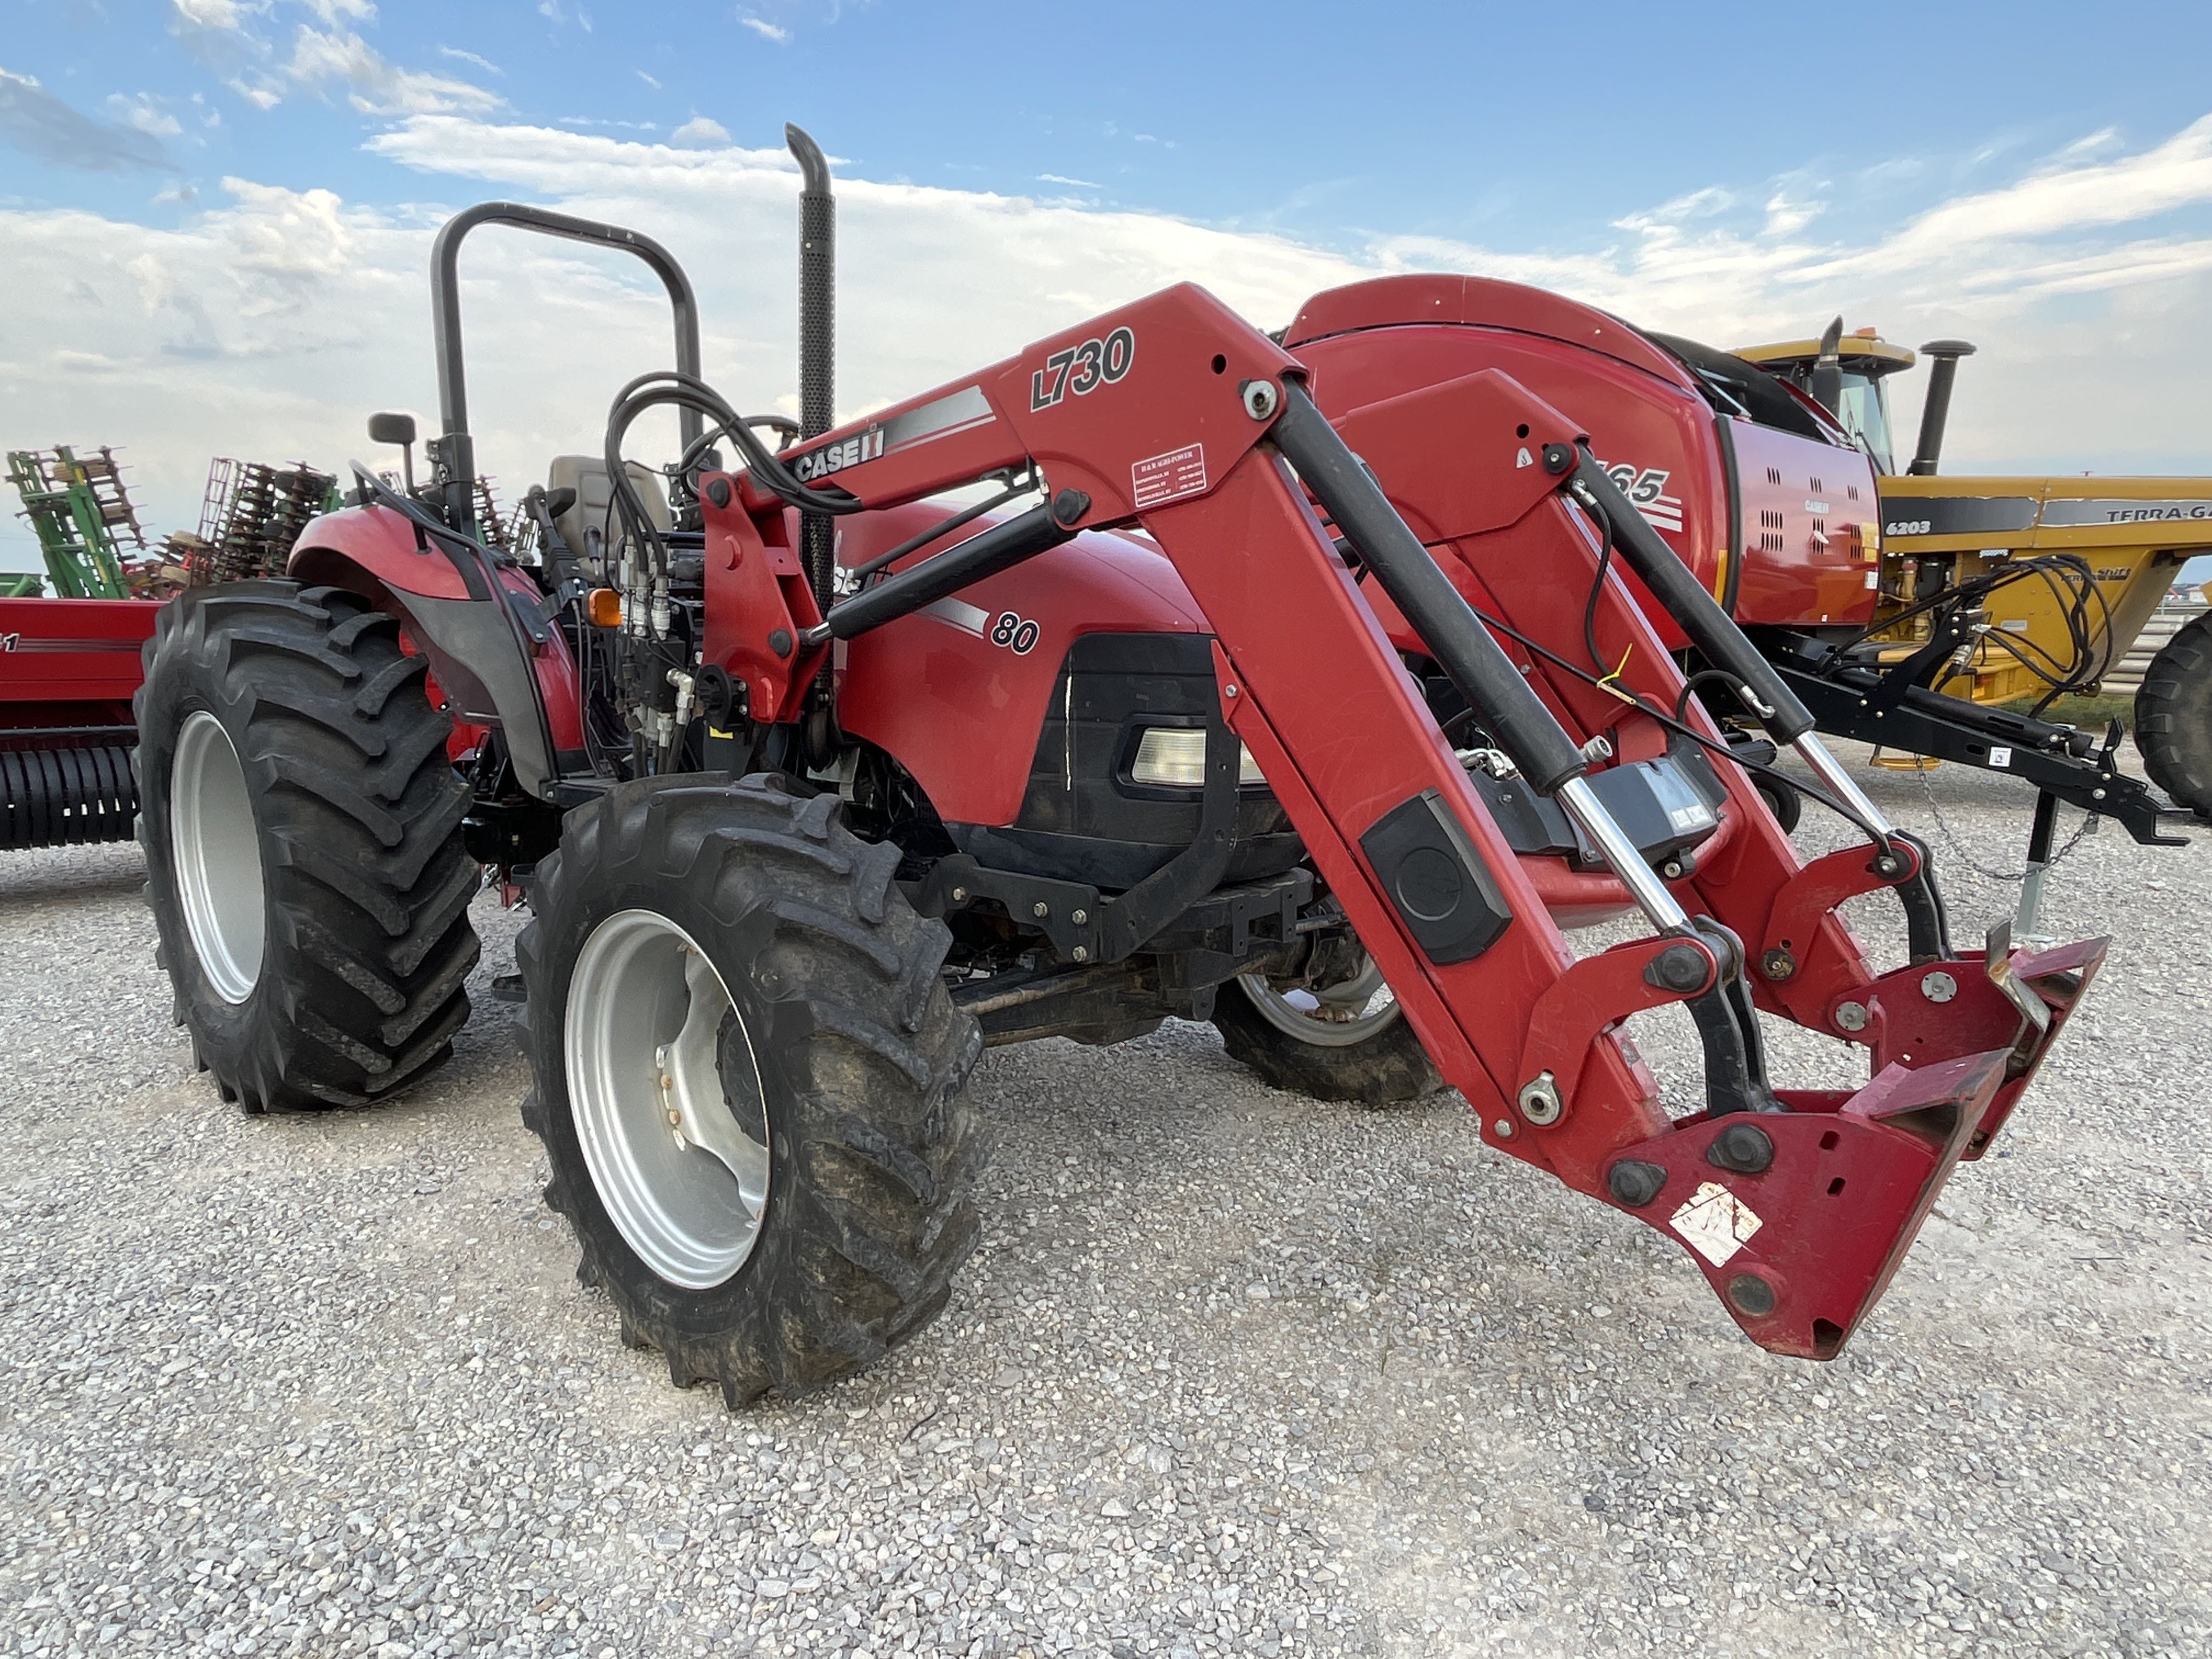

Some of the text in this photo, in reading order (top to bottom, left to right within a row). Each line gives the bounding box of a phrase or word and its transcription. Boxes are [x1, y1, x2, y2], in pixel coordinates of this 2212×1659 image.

[1030, 326, 1135, 413] L730
[796, 439, 859, 482] CASE
[1595, 460, 1670, 506] 65
[1886, 520, 1931, 535] 6203
[990, 611, 1040, 656] 80
